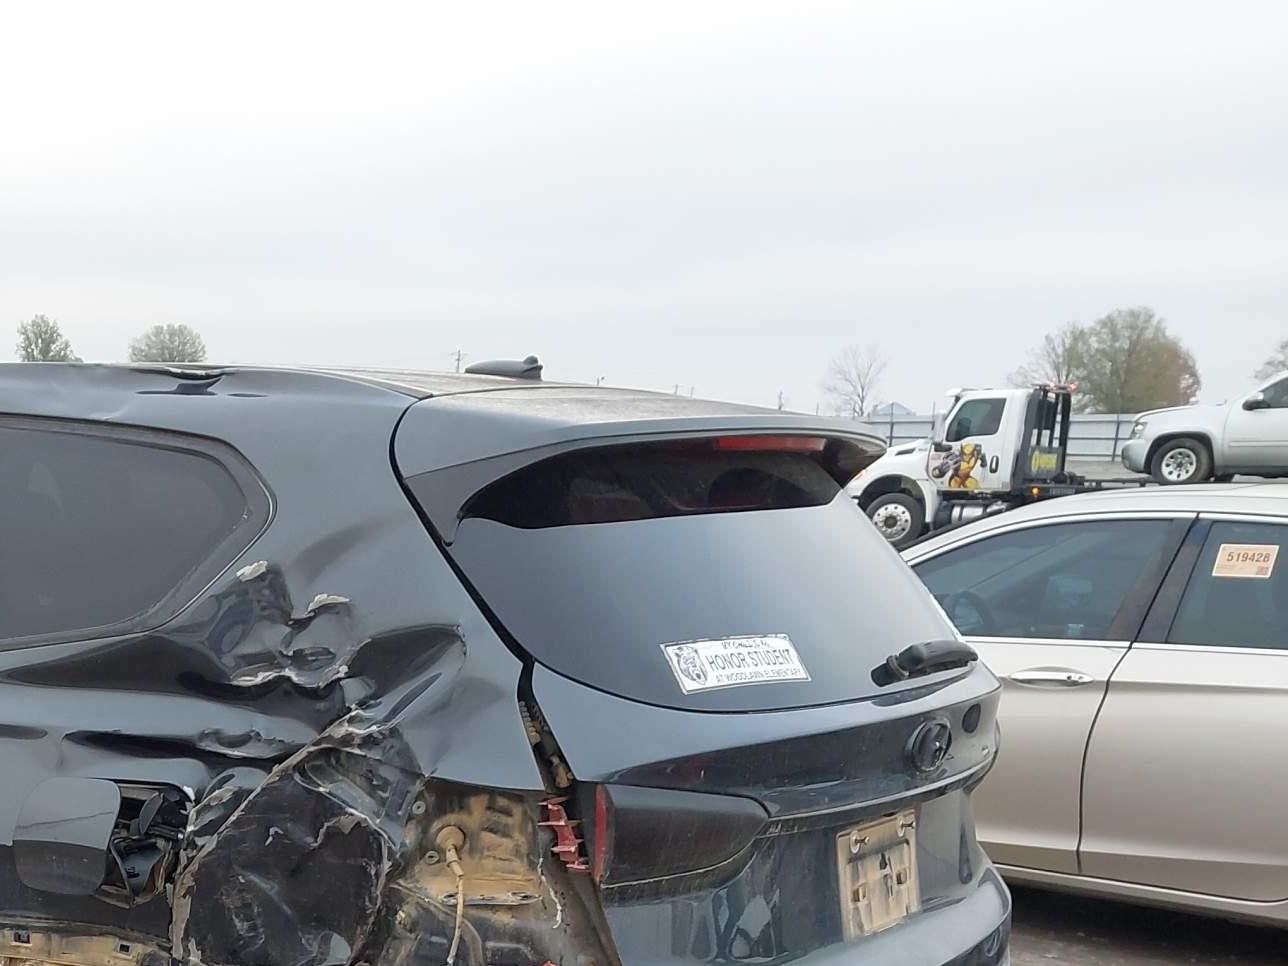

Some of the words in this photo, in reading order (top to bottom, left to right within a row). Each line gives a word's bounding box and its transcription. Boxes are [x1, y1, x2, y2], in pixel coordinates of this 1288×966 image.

[1226, 551, 1271, 562] 519428
[706, 652, 749, 671] HONOR
[747, 649, 795, 668] STUDENT
